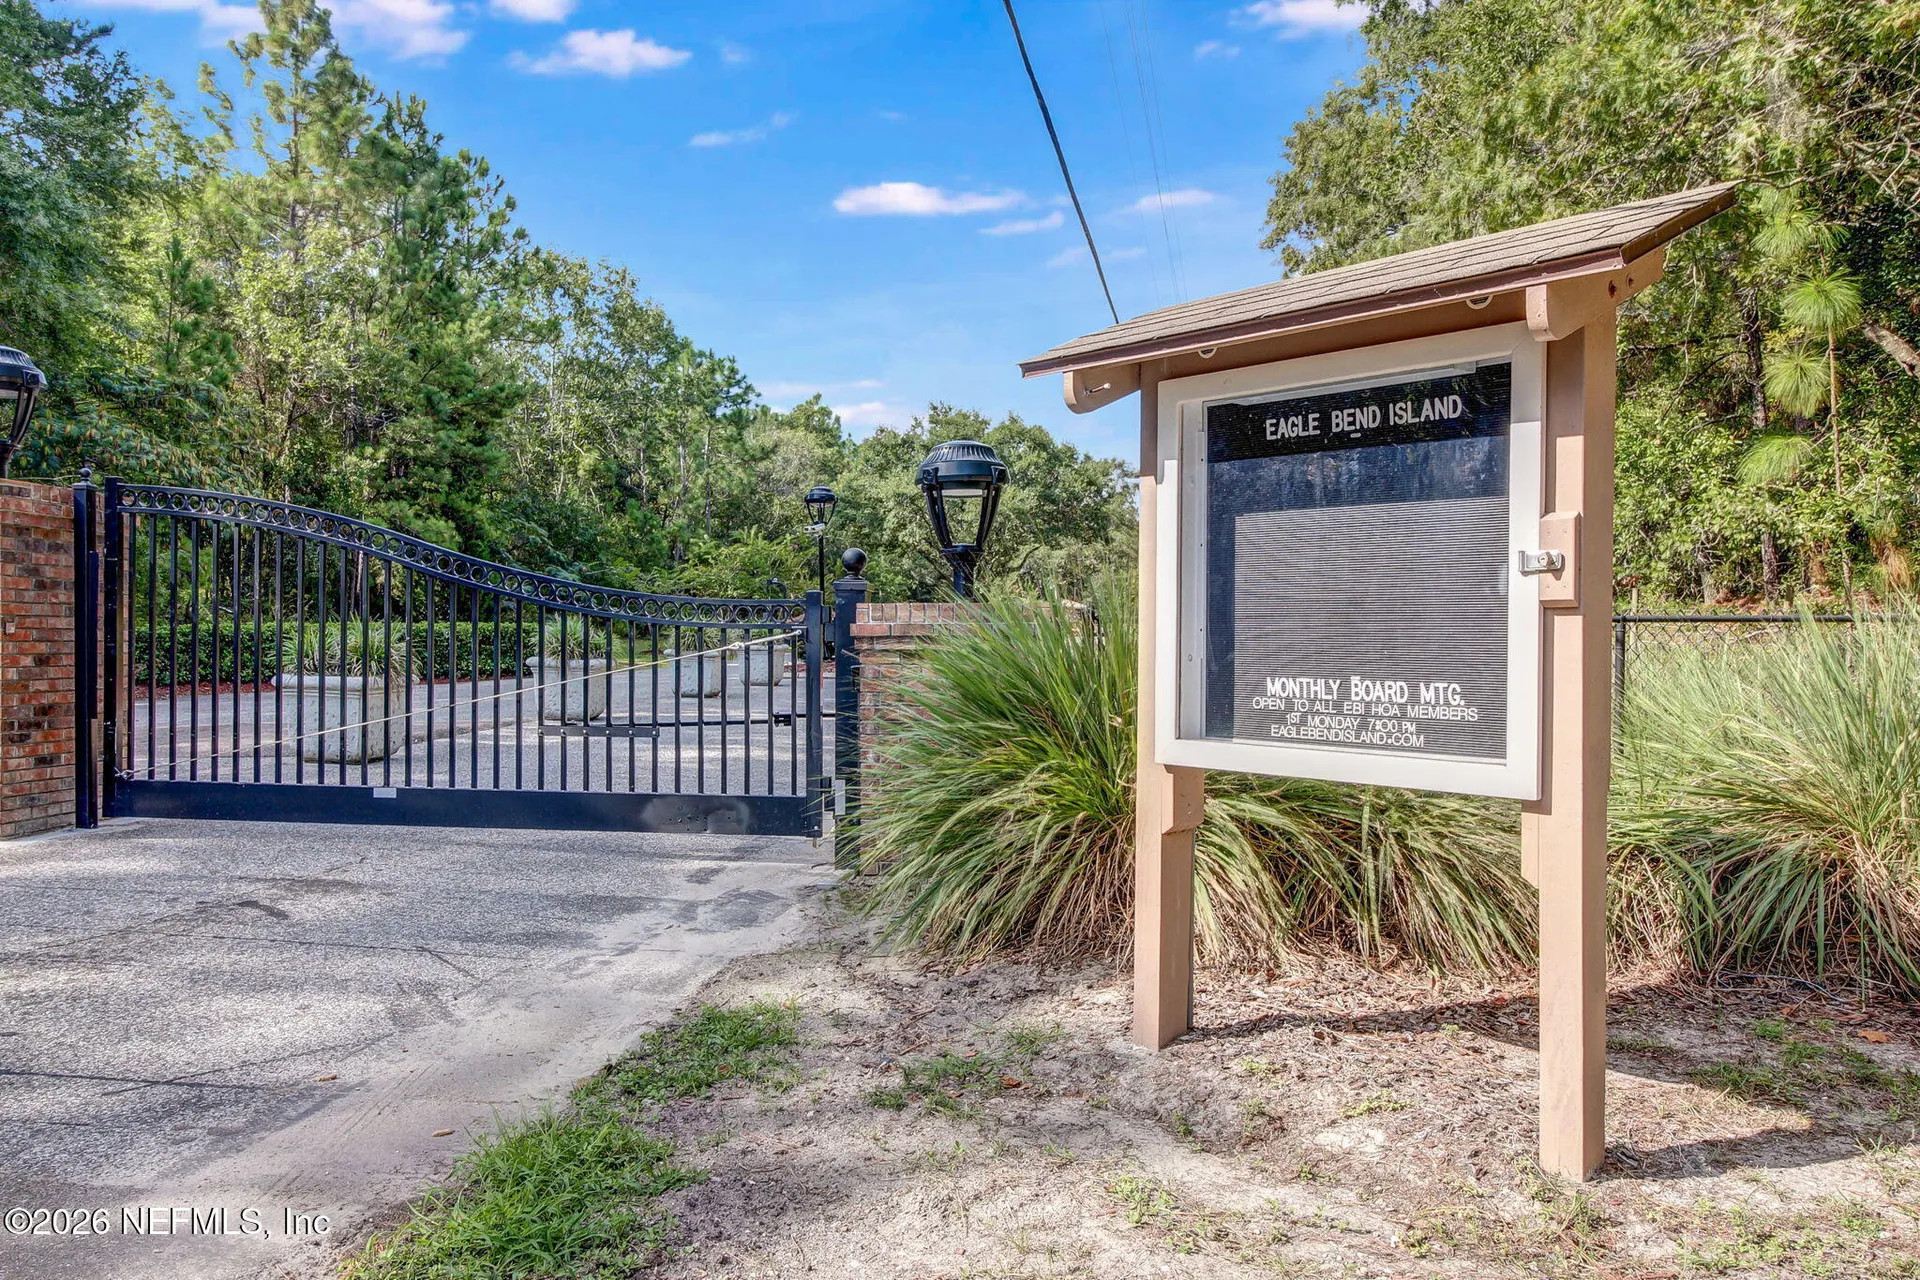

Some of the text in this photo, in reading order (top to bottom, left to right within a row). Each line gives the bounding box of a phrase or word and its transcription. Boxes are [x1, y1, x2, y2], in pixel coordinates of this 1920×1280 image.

[1266, 395, 1463, 440] EAGLE BEND ISLAND
[1266, 677, 1465, 706] MONTHLY BOARD MTG.
[1253, 697, 1478, 721] OPEN TO ALL EBI HOA MEMBERS
[1286, 713, 1416, 734] 1ST MONDAY 7:00 PM
[1271, 725, 1424, 747] EAGLEBENDISLAND.COM
